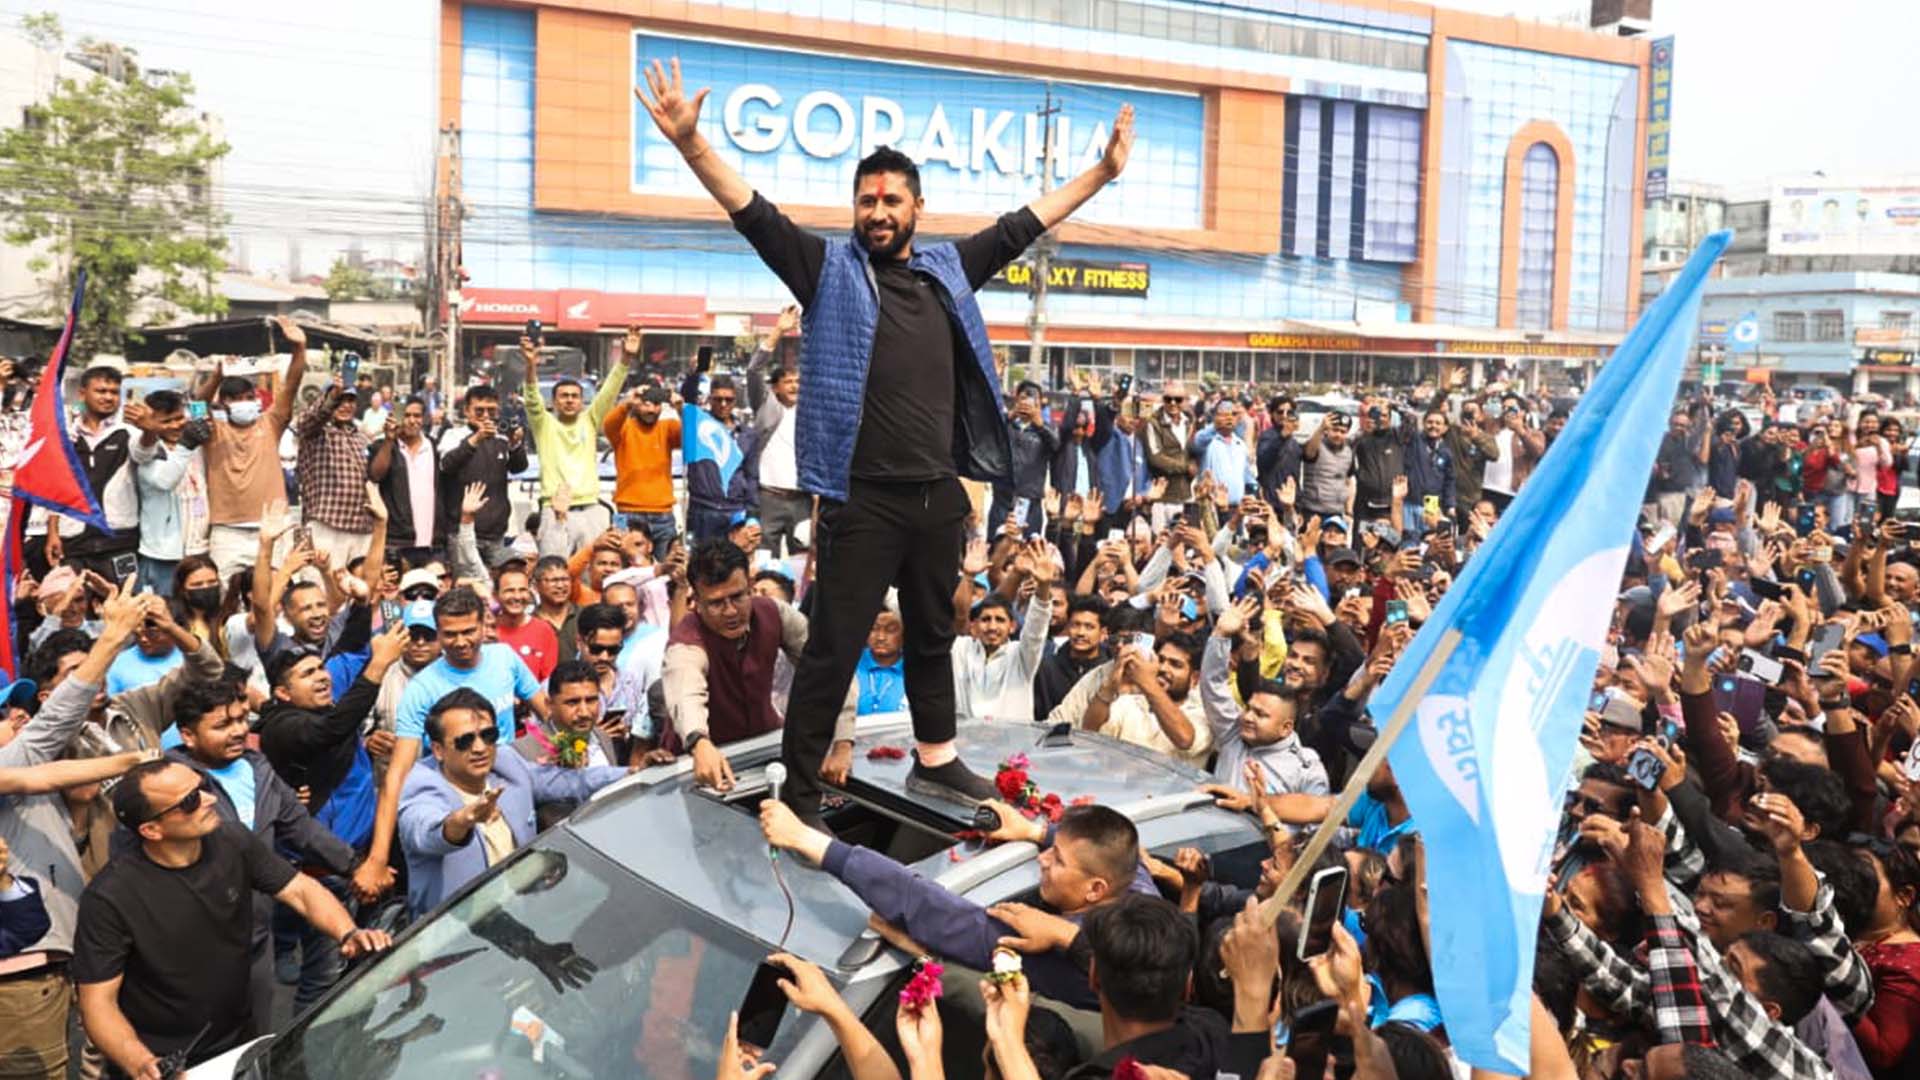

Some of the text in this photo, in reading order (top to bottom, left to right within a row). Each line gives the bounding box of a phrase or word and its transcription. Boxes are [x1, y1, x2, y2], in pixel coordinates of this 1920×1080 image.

[1083, 268, 1147, 290] FITNESS
[475, 303, 541, 314] HONDA
[1250, 334, 1309, 348] GORAKHA
